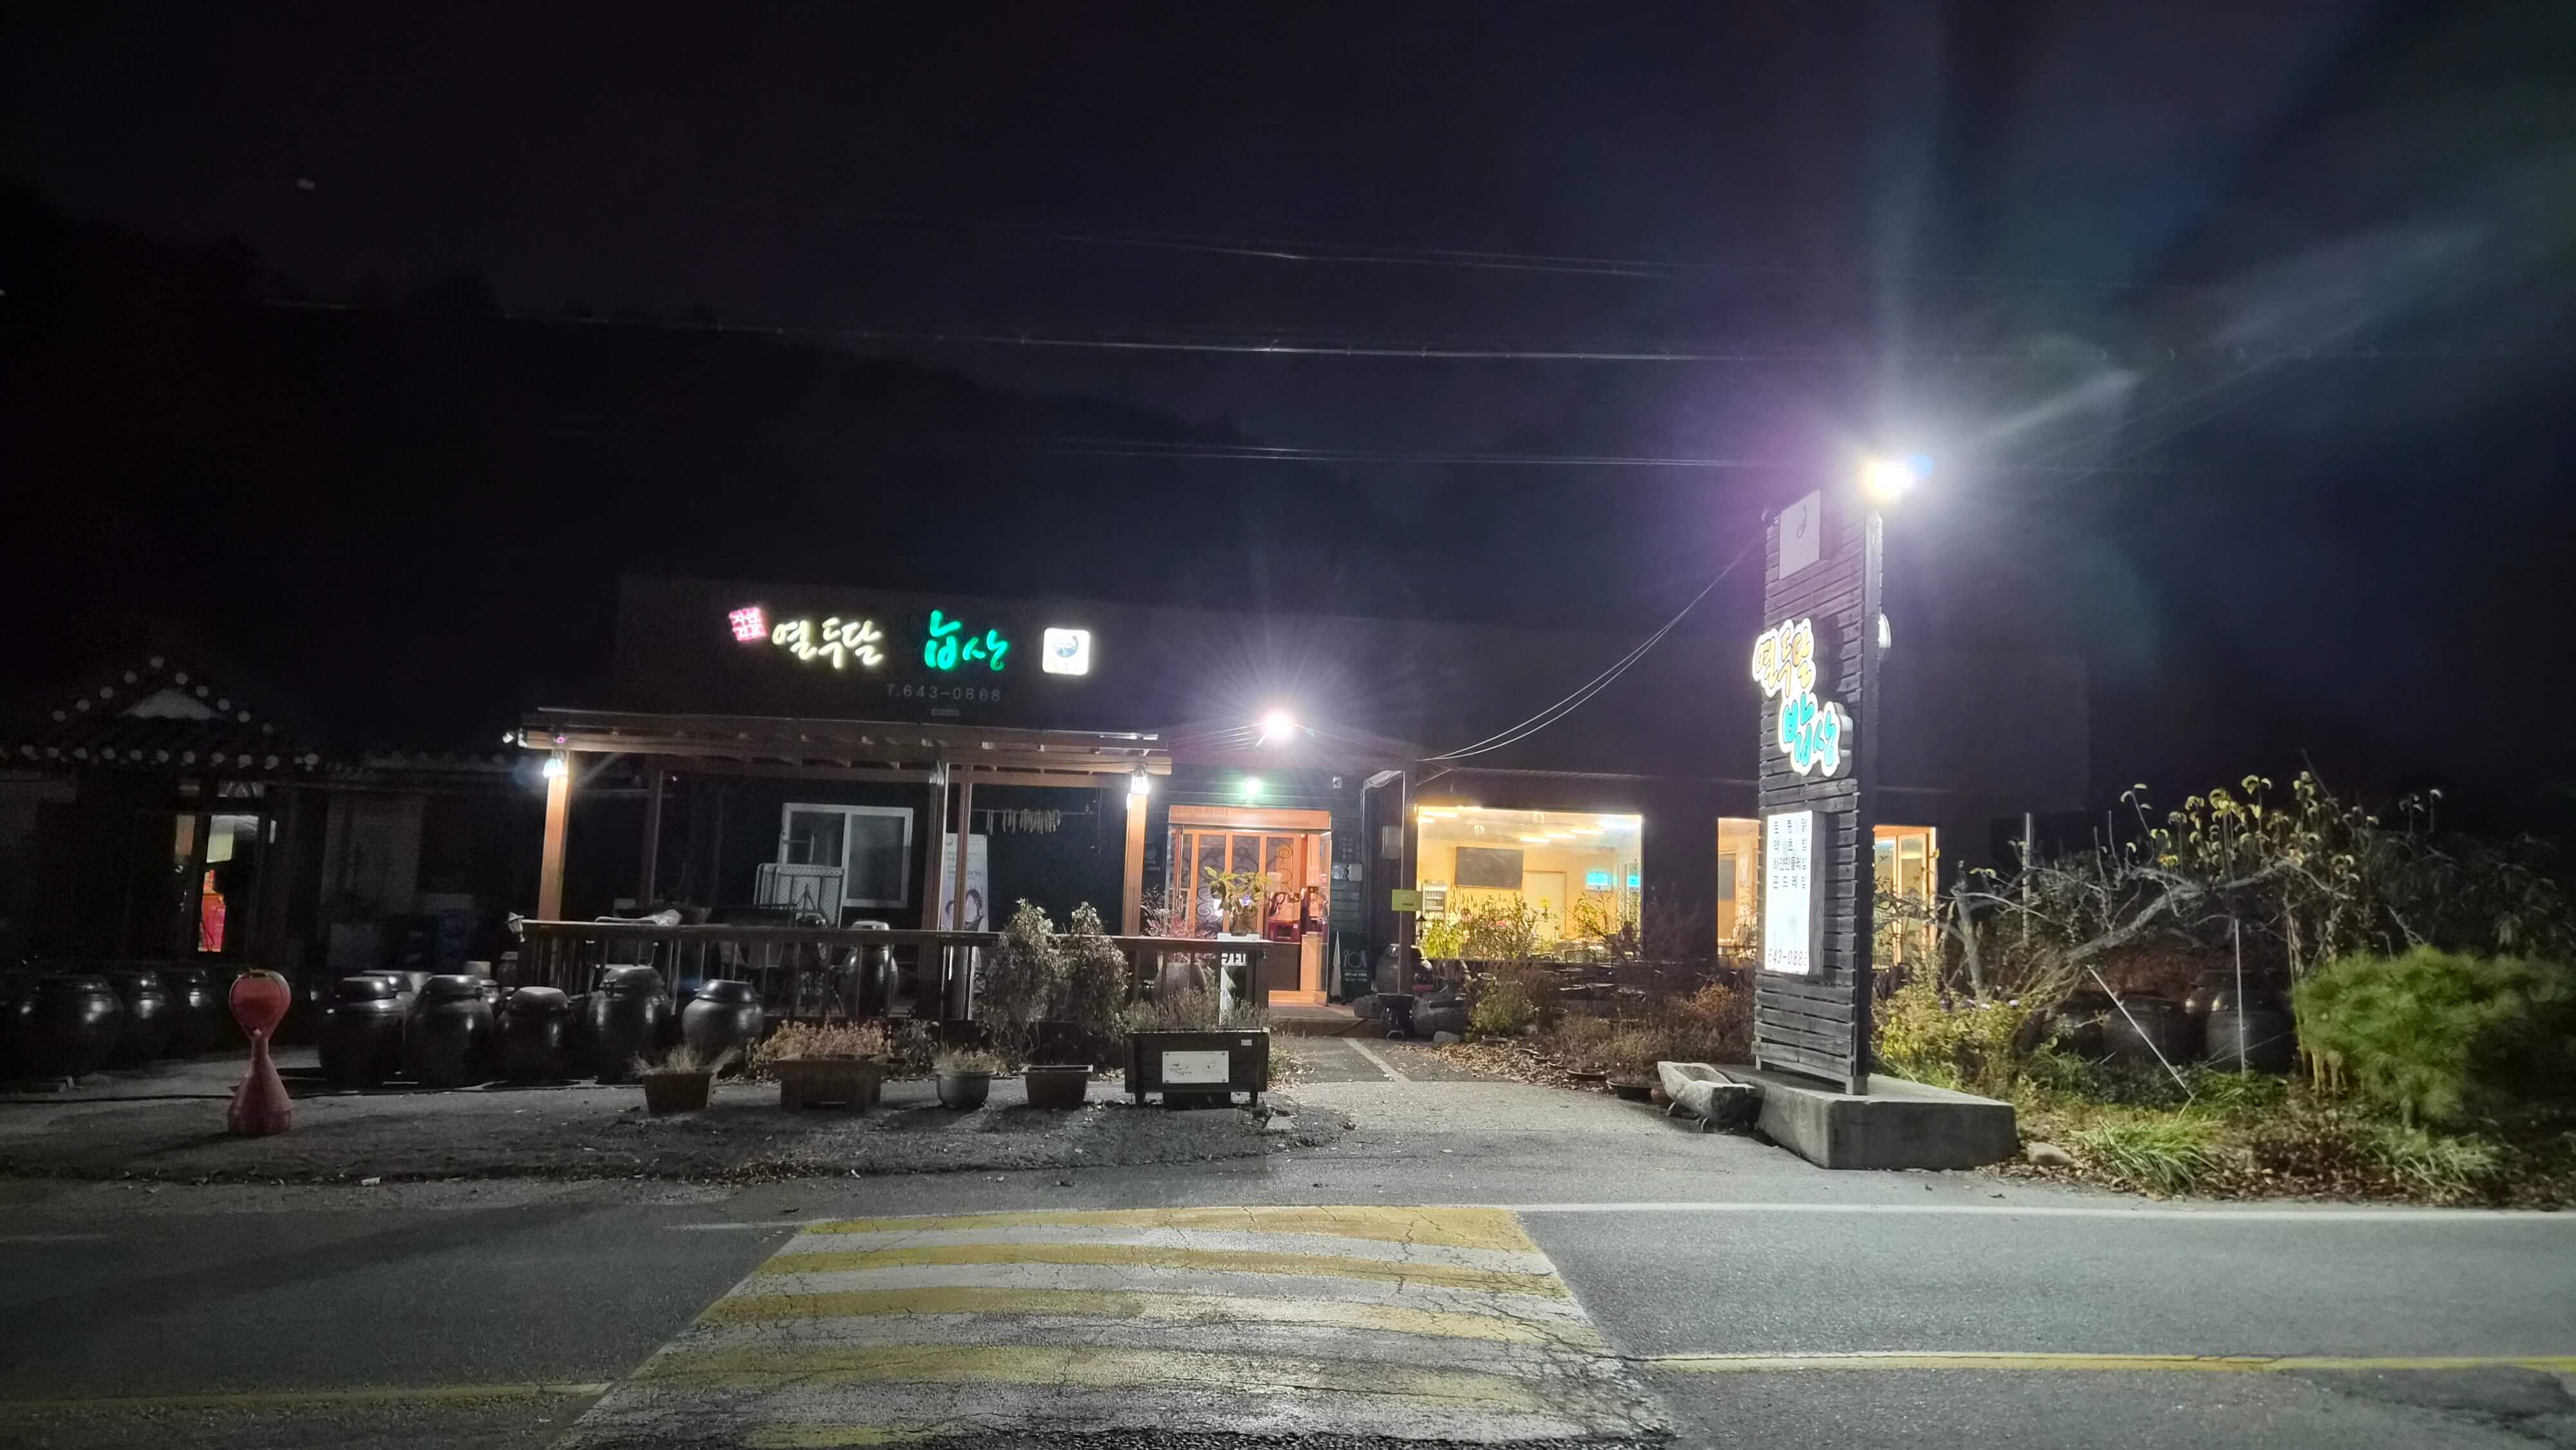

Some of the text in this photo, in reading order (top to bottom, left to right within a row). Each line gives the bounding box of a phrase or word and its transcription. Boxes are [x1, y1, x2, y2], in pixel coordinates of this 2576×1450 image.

[772, 616, 884, 670] 열두달
[1756, 623, 1813, 698] 열두달
[1782, 692, 1837, 767] 밥상
